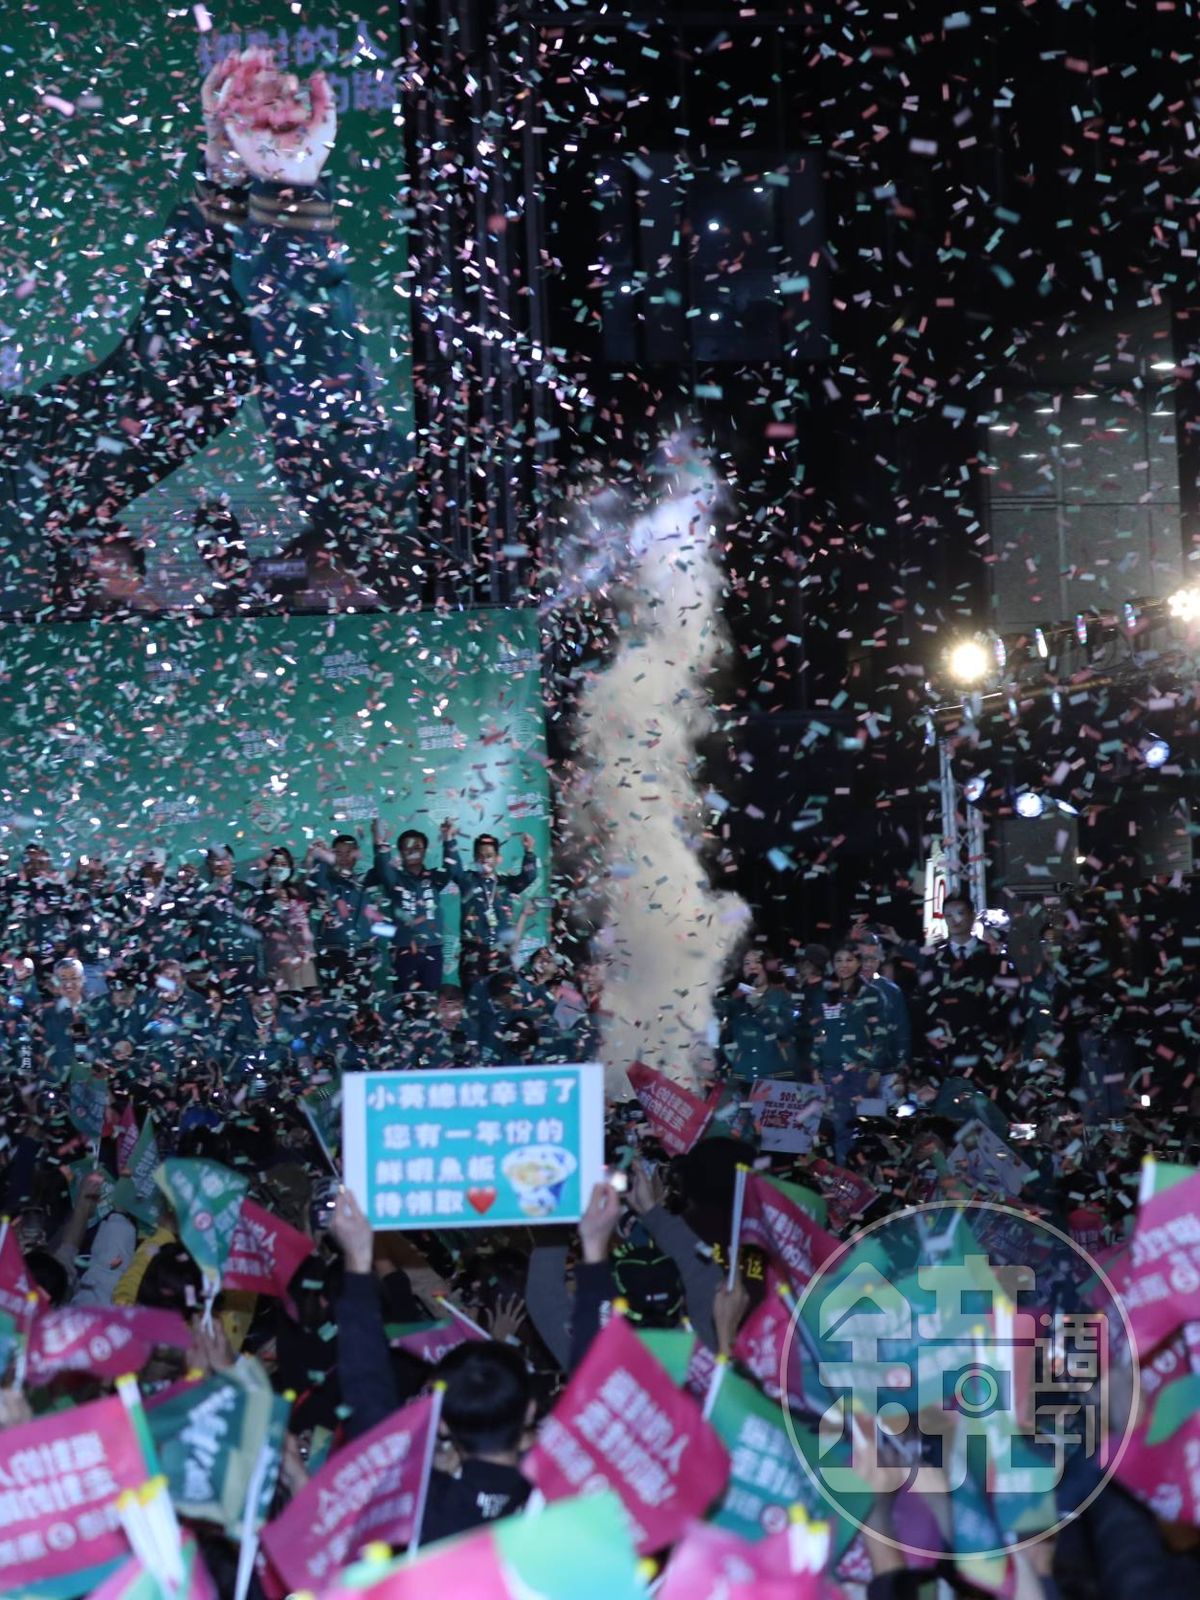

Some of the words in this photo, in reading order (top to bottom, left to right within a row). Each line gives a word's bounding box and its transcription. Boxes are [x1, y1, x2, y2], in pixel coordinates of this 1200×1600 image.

[367, 1077, 577, 1111] 小英總統辛苦了
[382, 1117, 564, 1150] 您有一年份的
[375, 1155, 496, 1185] 鮮蝦魚板
